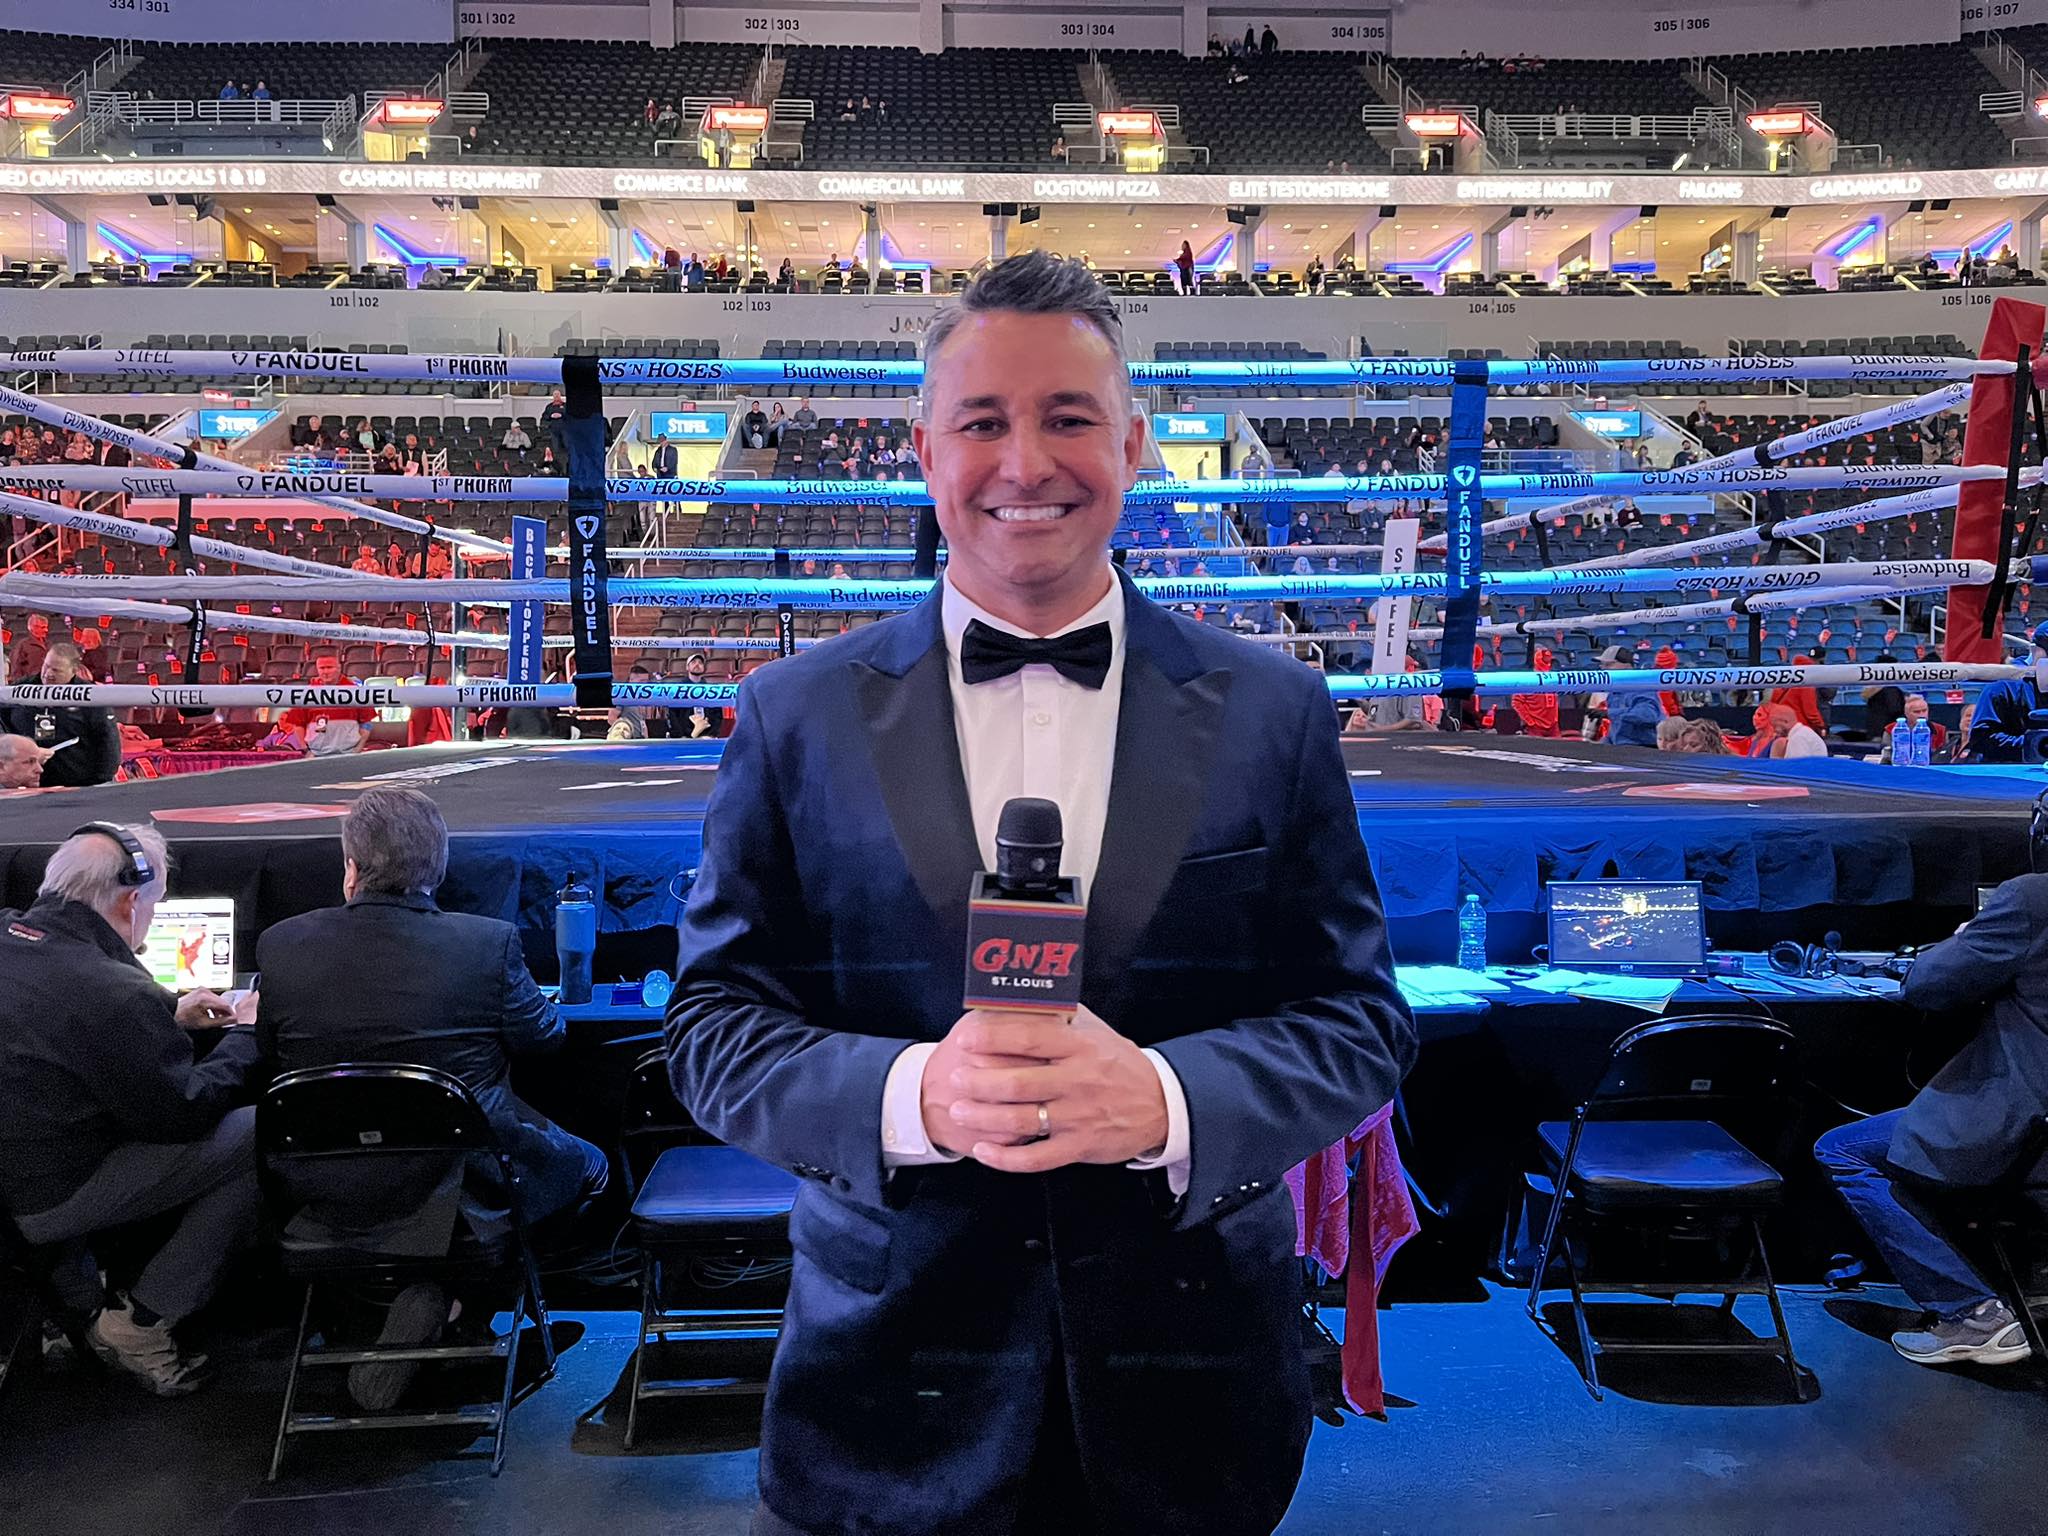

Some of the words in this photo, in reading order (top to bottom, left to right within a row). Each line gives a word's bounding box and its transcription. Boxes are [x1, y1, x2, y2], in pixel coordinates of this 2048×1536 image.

[146, 1, 170, 13] 301
[1994, 3, 2019, 16] 307
[461, 13, 482, 24] 301
[492, 13, 515, 25] 302
[745, 18, 767, 30] 302
[777, 19, 799, 30] 303
[1654, 20, 1677, 32] 305
[1686, 18, 1710, 30] 306
[1061, 24, 1083, 35] 303
[1092, 24, 1114, 36] 304
[1331, 27, 1353, 38] 304
[1363, 27, 1385, 38] 305
[30, 169, 154, 187] CRAFTWORKERS
[155, 169, 216, 186] LOCALS
[219, 169, 227, 186] 1
[229, 169, 244, 186] &
[338, 170, 412, 188] CASHION
[414, 171, 448, 188] FIRE
[449, 171, 542, 190] EQUIPMENT
[613, 175, 703, 192] COMMERCE
[705, 176, 749, 193] BANK
[1994, 172, 2039, 190] GARY
[818, 178, 920, 195] COMMERCIAL
[922, 178, 965, 196] BANK
[1033, 180, 1115, 197] DOGTOWN
[1116, 180, 1160, 197] PIZZA
[1229, 181, 1267, 198] ELITE
[1457, 181, 1543, 198] ENTERPRISE
[1543, 181, 1614, 198] MOBILITY
[1809, 177, 1923, 197] GARDAWORLD
[330, 296, 349, 307] 101
[358, 297, 379, 308] 102
[723, 300, 743, 311] 102
[751, 301, 771, 312] 103
[1128, 303, 1148, 314] 104
[1469, 303, 1488, 313] 104
[1496, 303, 1516, 314] 105
[1941, 295, 1962, 306] 105
[1971, 294, 1991, 305] 106
[256, 352, 368, 372] FANDUEL
[449, 358, 508, 376] PHORM
[598, 362, 626, 378] NS
[647, 362, 723, 379] HOSES
[782, 362, 887, 380] Budweiser
[1129, 364, 1192, 379] RTGAGE
[1372, 362, 1456, 377] FANDUE
[1546, 360, 1599, 375] PHORM
[1648, 359, 1705, 371] GUNS
[1726, 357, 1794, 370] HOSES
[668, 418, 709, 434] STIFEL
[121, 477, 177, 493] STIFEL
[261, 475, 373, 493] FANDUEL
[454, 478, 512, 493] PHORM
[1368, 476, 1447, 492] FANDU
[1541, 474, 1594, 489] PHORM
[1642, 471, 1699, 485] GUNS
[1719, 469, 1788, 483] HOSES
[651, 480, 726, 496] HOSES
[1459, 491, 1471, 589] FANDUEL
[1873, 562, 1970, 578] Budweiser
[582, 544, 598, 645] FANDUEL
[1154, 582, 1229, 600] MORTGAGE
[1281, 580, 1332, 596] STIFEL
[520, 528, 534, 681] BACKOPPERS
[1386, 547, 1403, 657] SFEL
[192, 599, 204, 664] ANDUEL
[783, 624, 791, 653] FANDU
[1557, 671, 1611, 686] PHORM
[1659, 670, 1716, 685] GUNS
[1735, 669, 1805, 685] HOSES
[1859, 665, 1957, 681] Budweiser
[151, 688, 208, 705] STIFEL
[291, 688, 401, 705] FANDUEL
[479, 686, 537, 702] PHORM
[612, 684, 652, 699] UNS
[992, 977, 1012, 986] ST.
[1013, 977, 1054, 988] LOUIS
